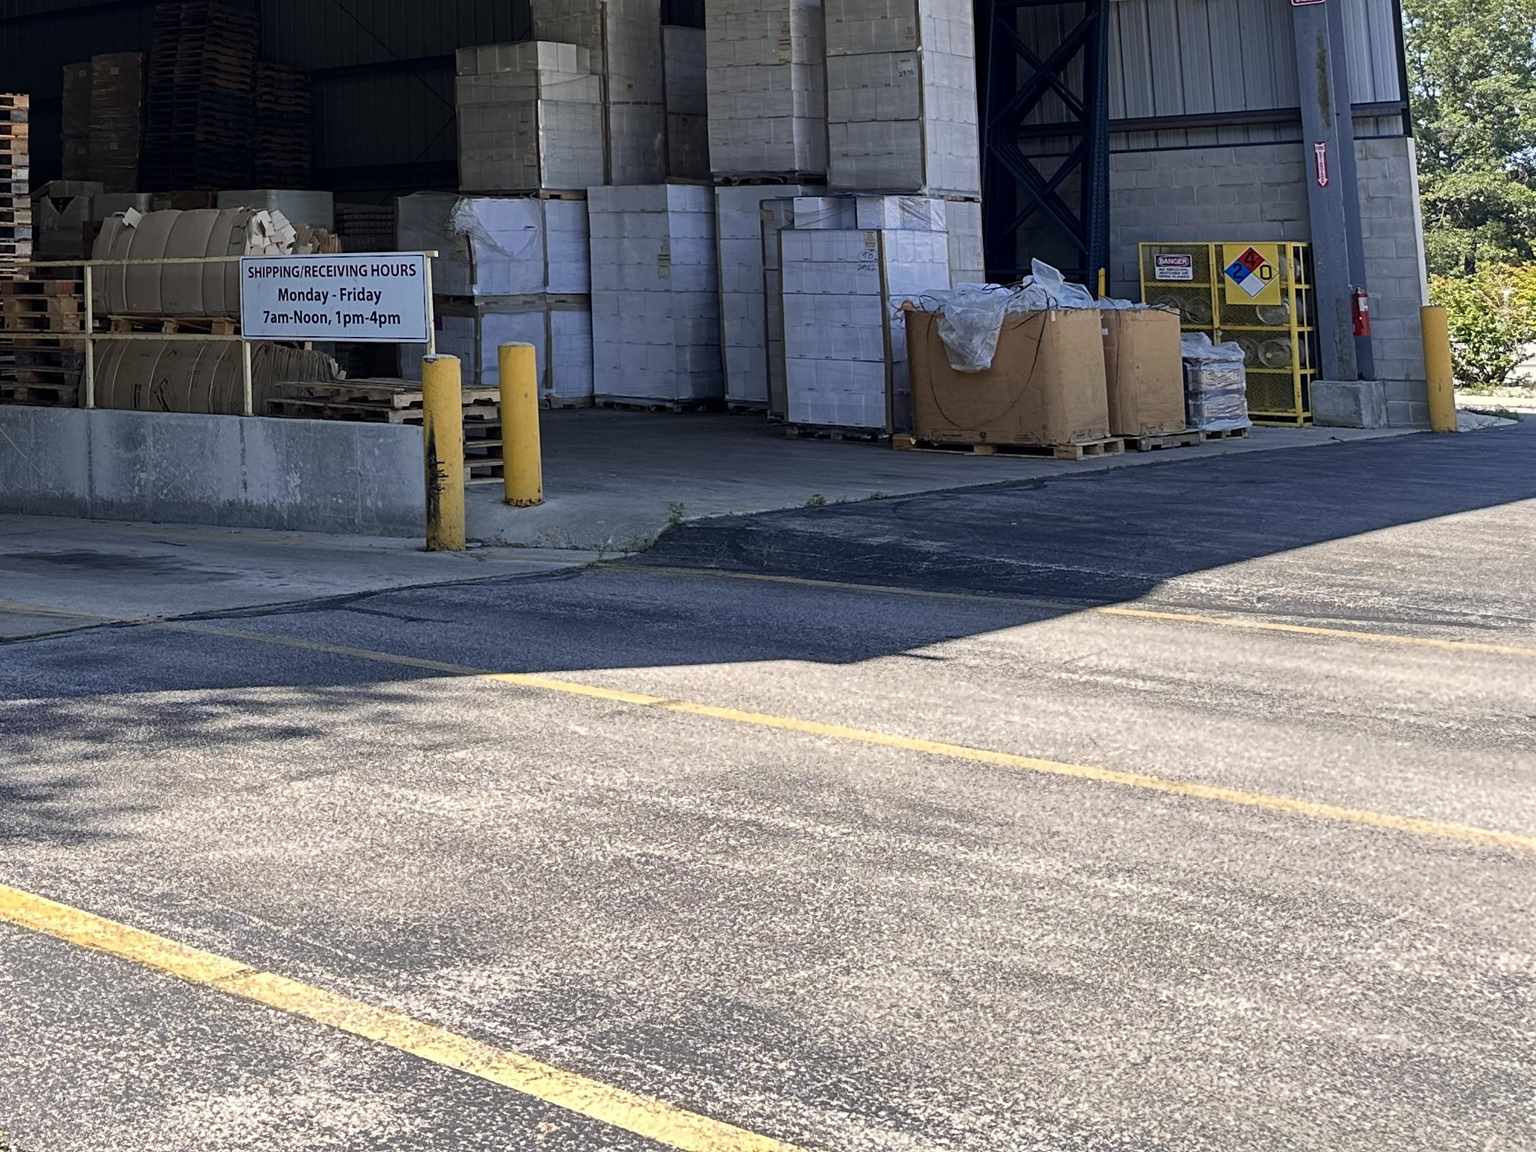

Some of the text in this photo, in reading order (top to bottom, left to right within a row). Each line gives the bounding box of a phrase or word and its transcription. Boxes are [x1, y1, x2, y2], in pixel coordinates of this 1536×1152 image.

[1158, 257, 1187, 266] DANGER
[248, 263, 417, 279] SHIPPING/RECEIVING HOURS
[1233, 262, 1243, 280] 2
[1260, 265, 1272, 280] 0
[278, 288, 329, 305] Monday
[339, 288, 382, 305] Friday
[263, 310, 401, 328] 7am-Noon, 1pm-4pm
